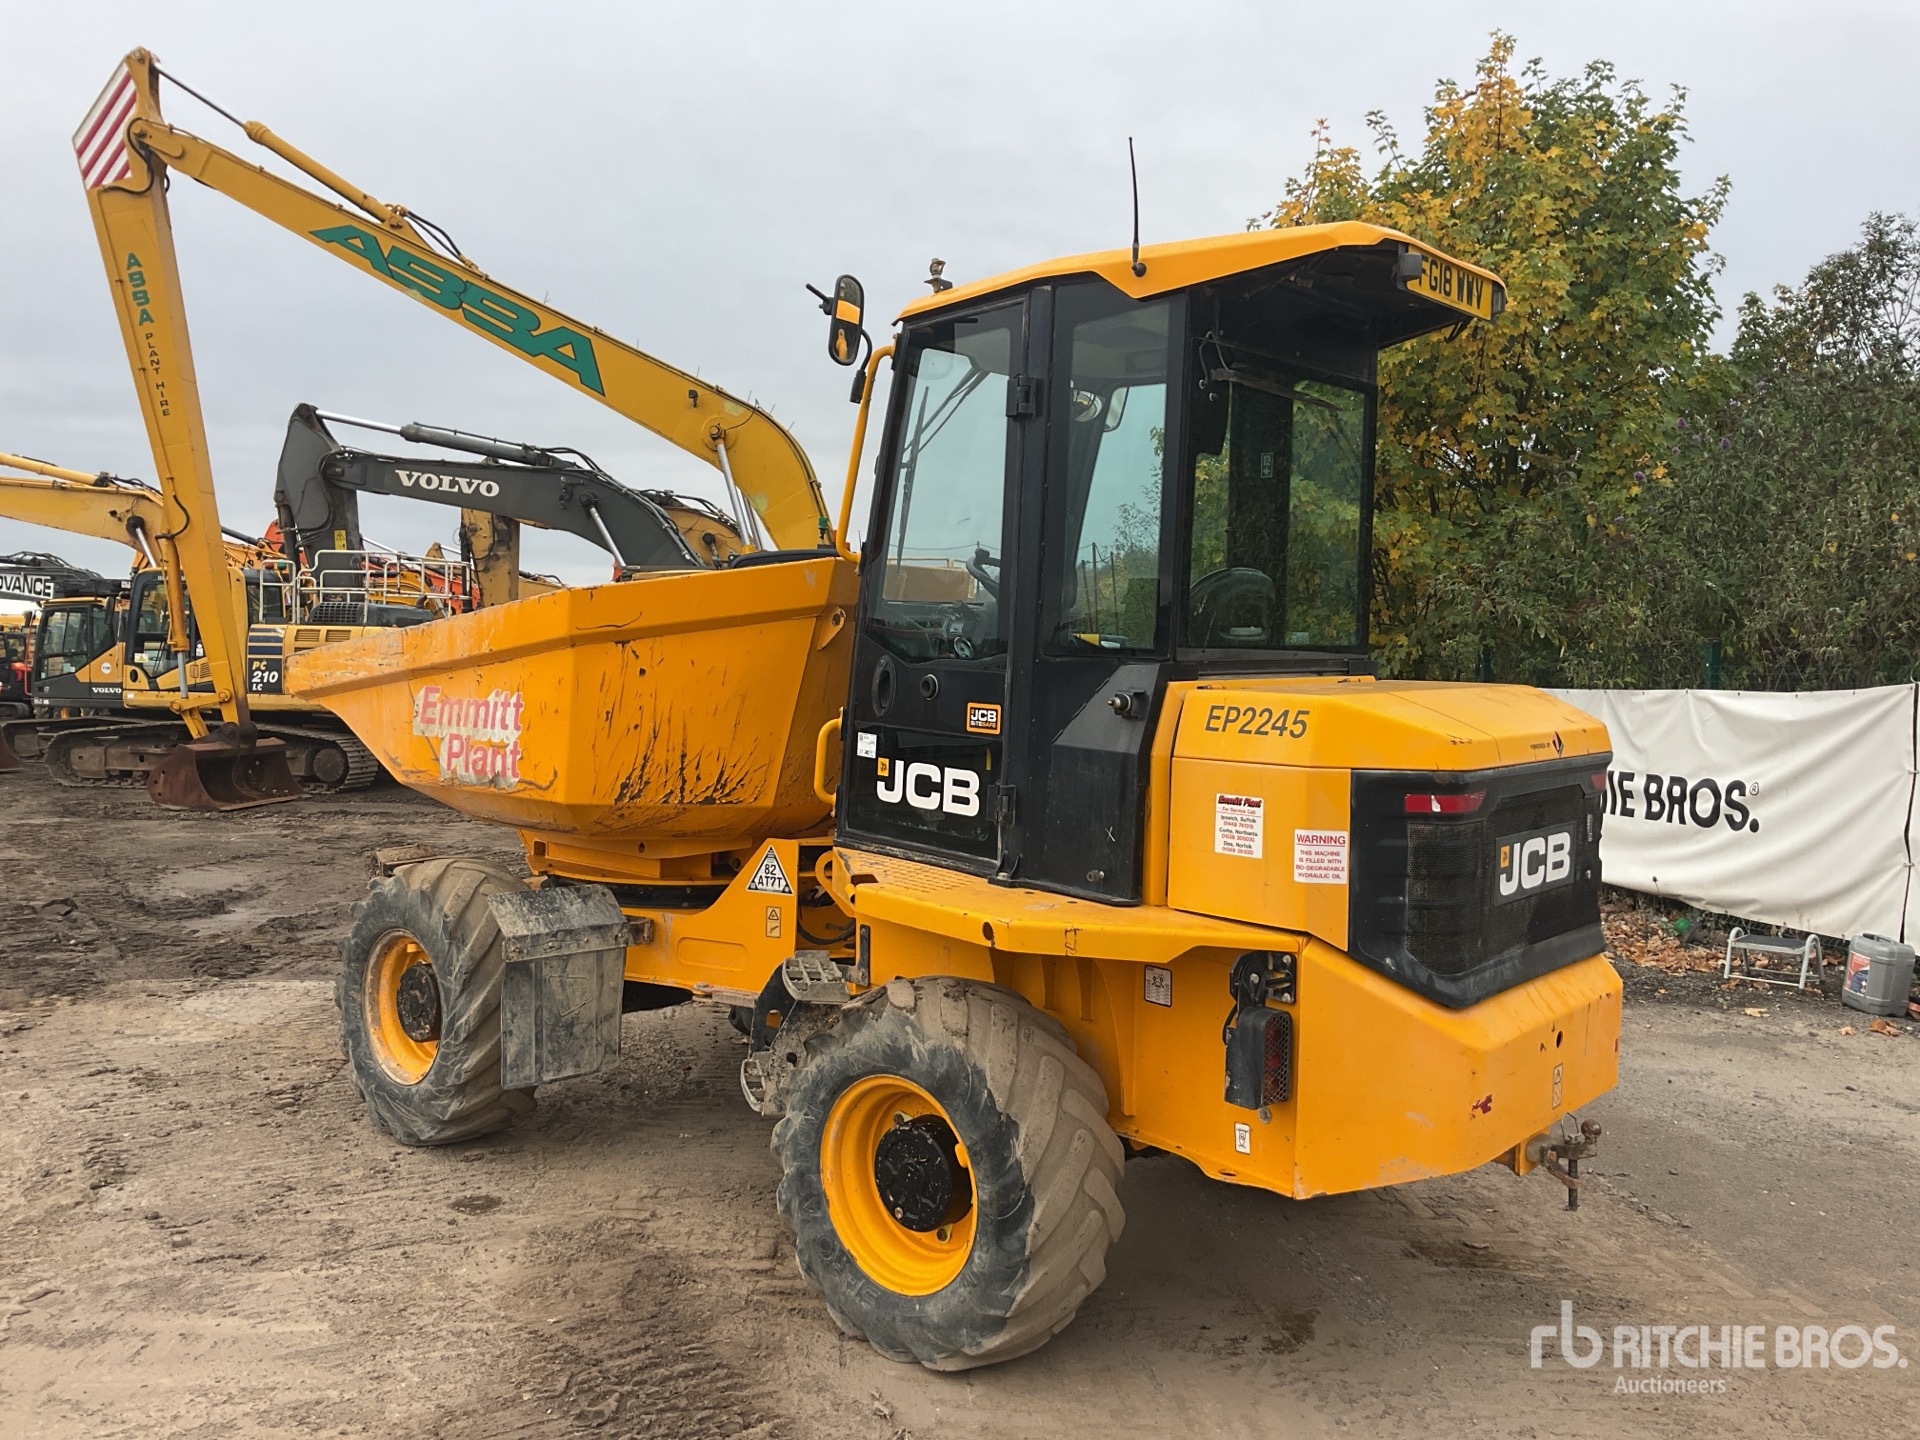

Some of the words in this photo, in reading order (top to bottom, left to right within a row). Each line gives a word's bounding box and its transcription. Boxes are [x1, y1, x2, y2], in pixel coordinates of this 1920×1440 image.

[126, 252, 154, 326] ABBA
[310, 224, 606, 397] ABBA
[145, 332, 160, 375] PLANT
[155, 381, 170, 416] HIRE
[395, 469, 500, 497] VOLVO
[252, 661, 267, 671] PC
[252, 671, 279, 683] 210
[252, 683, 263, 691] LC
[416, 685, 523, 733] Emmitt
[970, 709, 997, 722] JCB
[1205, 704, 1311, 739] EP2245
[445, 732, 522, 779] Plant
[876, 759, 980, 817] JCB
[1296, 834, 1346, 845] WARNING
[764, 863, 777, 876] 82
[1499, 831, 1571, 896] JCB
[757, 875, 783, 888] AT7T
